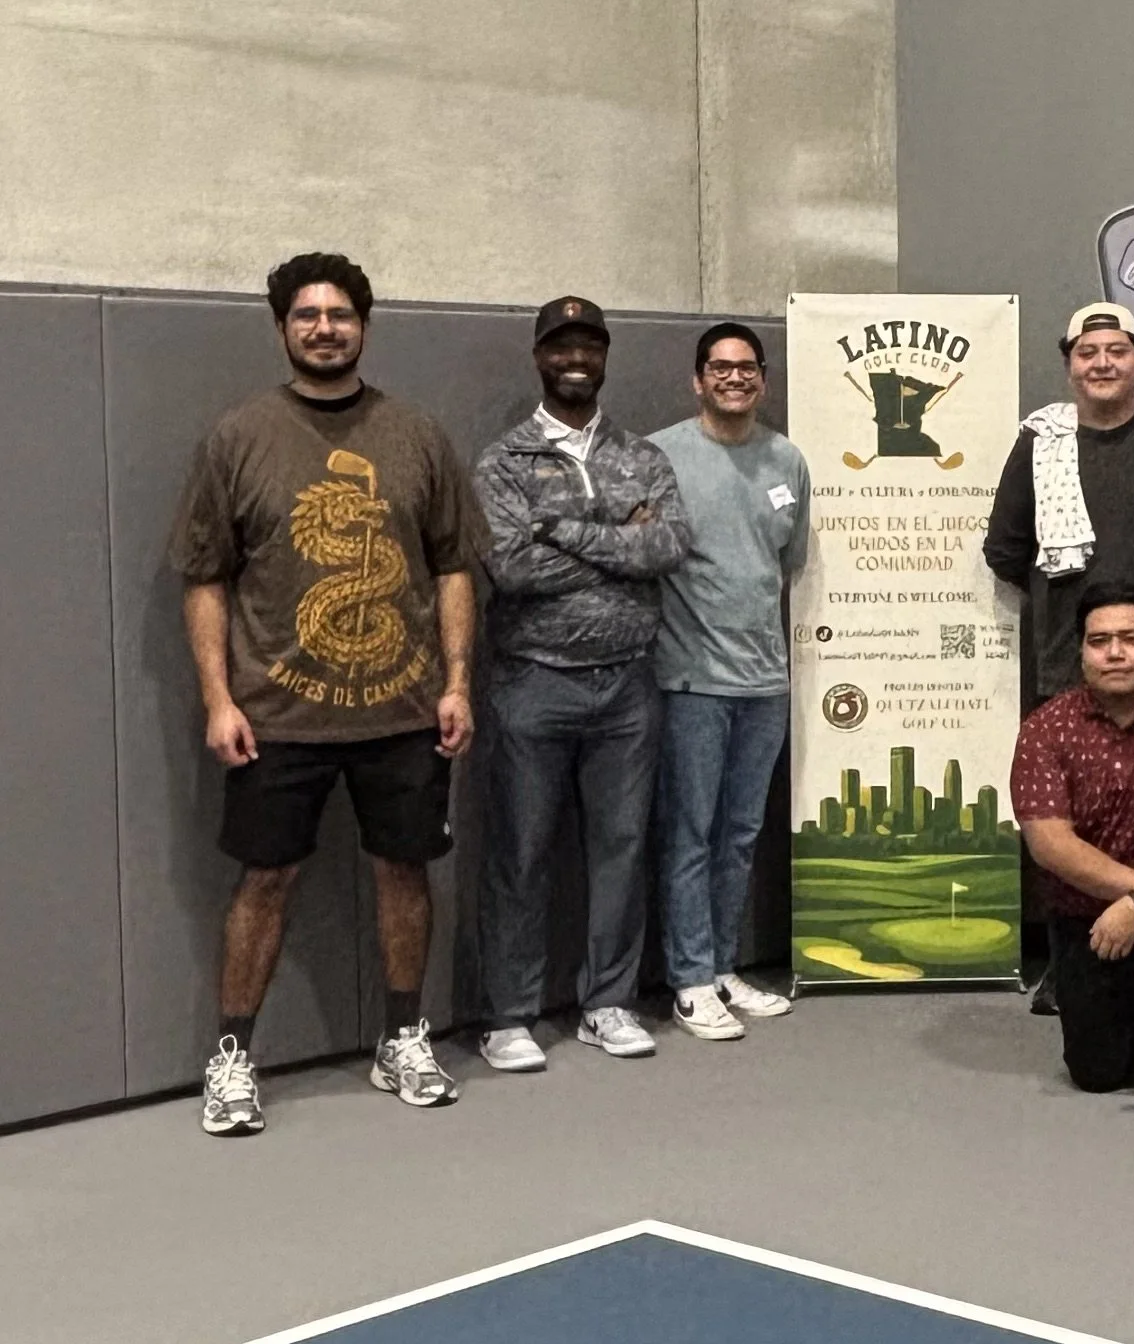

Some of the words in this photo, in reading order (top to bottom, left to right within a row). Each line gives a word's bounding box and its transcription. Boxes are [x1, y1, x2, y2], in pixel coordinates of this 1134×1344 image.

[837, 321, 970, 363] LATINO
[864, 353, 901, 370] GOLF
[910, 353, 950, 373] CLUB
[817, 517, 879, 531] JUNTOS
[888, 517, 907, 531] EN
[914, 517, 932, 531] EL
[938, 517, 989, 531] JUEGO
[849, 536, 910, 551] UNIDOS
[917, 536, 936, 551] EN
[944, 536, 963, 551] LA
[856, 556, 953, 571] COMUNIDAD
[333, 687, 356, 707] DE
